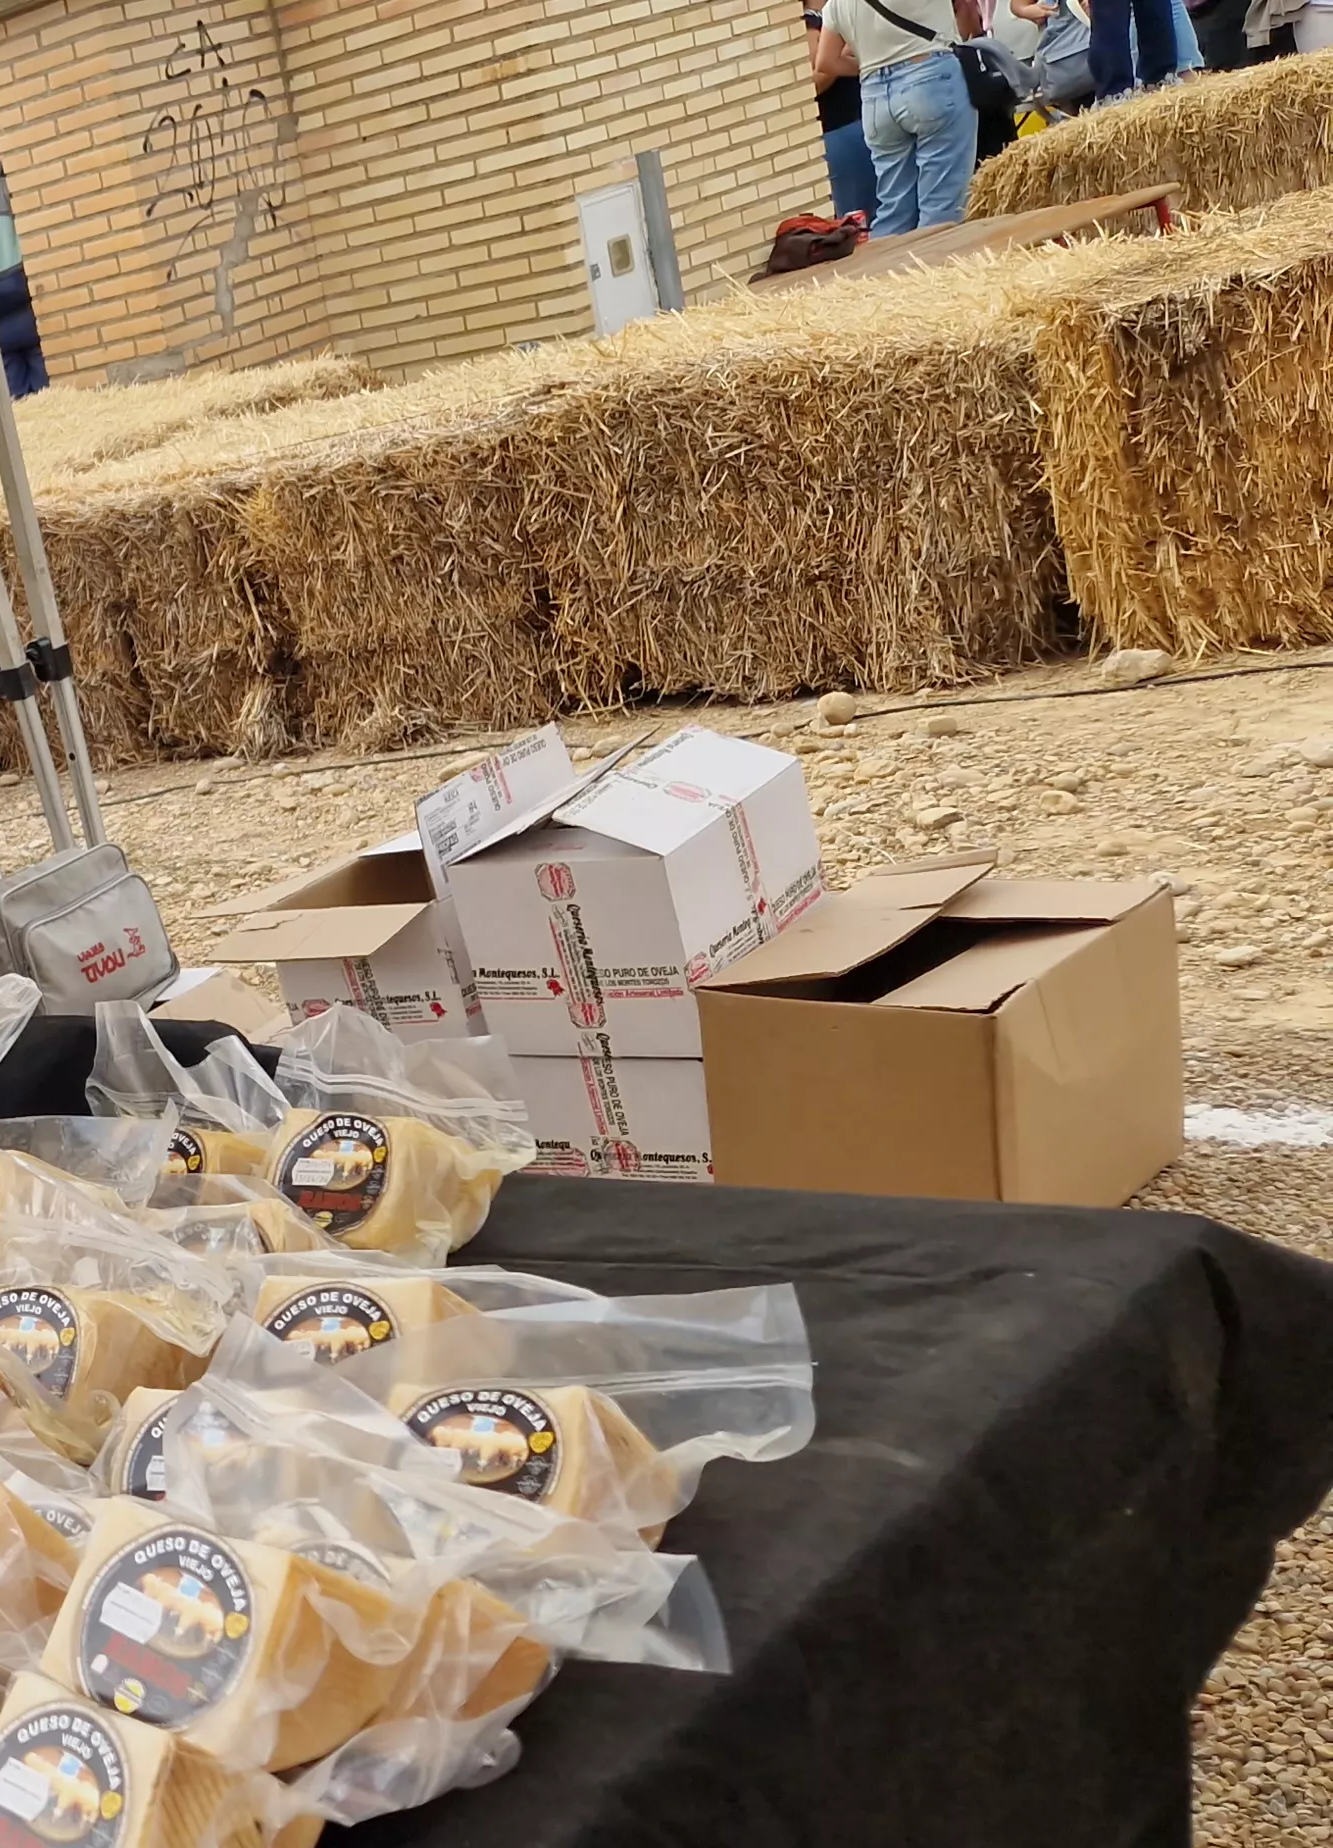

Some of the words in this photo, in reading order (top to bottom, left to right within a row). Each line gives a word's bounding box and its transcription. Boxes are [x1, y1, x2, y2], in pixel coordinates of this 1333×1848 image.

[478, 967, 541, 981] Montequesos,
[612, 968, 636, 978] PURO
[638, 968, 649, 977] DE
[651, 966, 679, 977] OVEJA
[302, 1120, 335, 1148] QUESO
[336, 1118, 351, 1127] DE
[354, 1120, 384, 1146] OVEJA
[333, 1129, 359, 1138] VIEJO
[614, 1111, 629, 1137] OVEJA
[16, 1304, 42, 1315] VIEJO
[21, 1292, 38, 1301] DE
[39, 1295, 70, 1327] OVEJA
[274, 1296, 316, 1330] QUESO
[320, 1292, 339, 1302] DE
[343, 1293, 382, 1322] OVEJA
[314, 1305, 348, 1315] VIEJO
[417, 1392, 474, 1423] QUESO
[478, 1392, 501, 1402] DE
[502, 1394, 547, 1432] OVEJA
[465, 1403, 507, 1416] VIEJO
[133, 1536, 185, 1565] QUESO
[188, 1538, 211, 1556] DE
[211, 1549, 247, 1612] OVEJA
[178, 1554, 215, 1583] VIEJO
[16, 1714, 70, 1743] QUESO
[70, 1718, 92, 1736] DE
[90, 1731, 123, 1791] OVEJA
[61, 1732, 93, 1761] VIEJO
